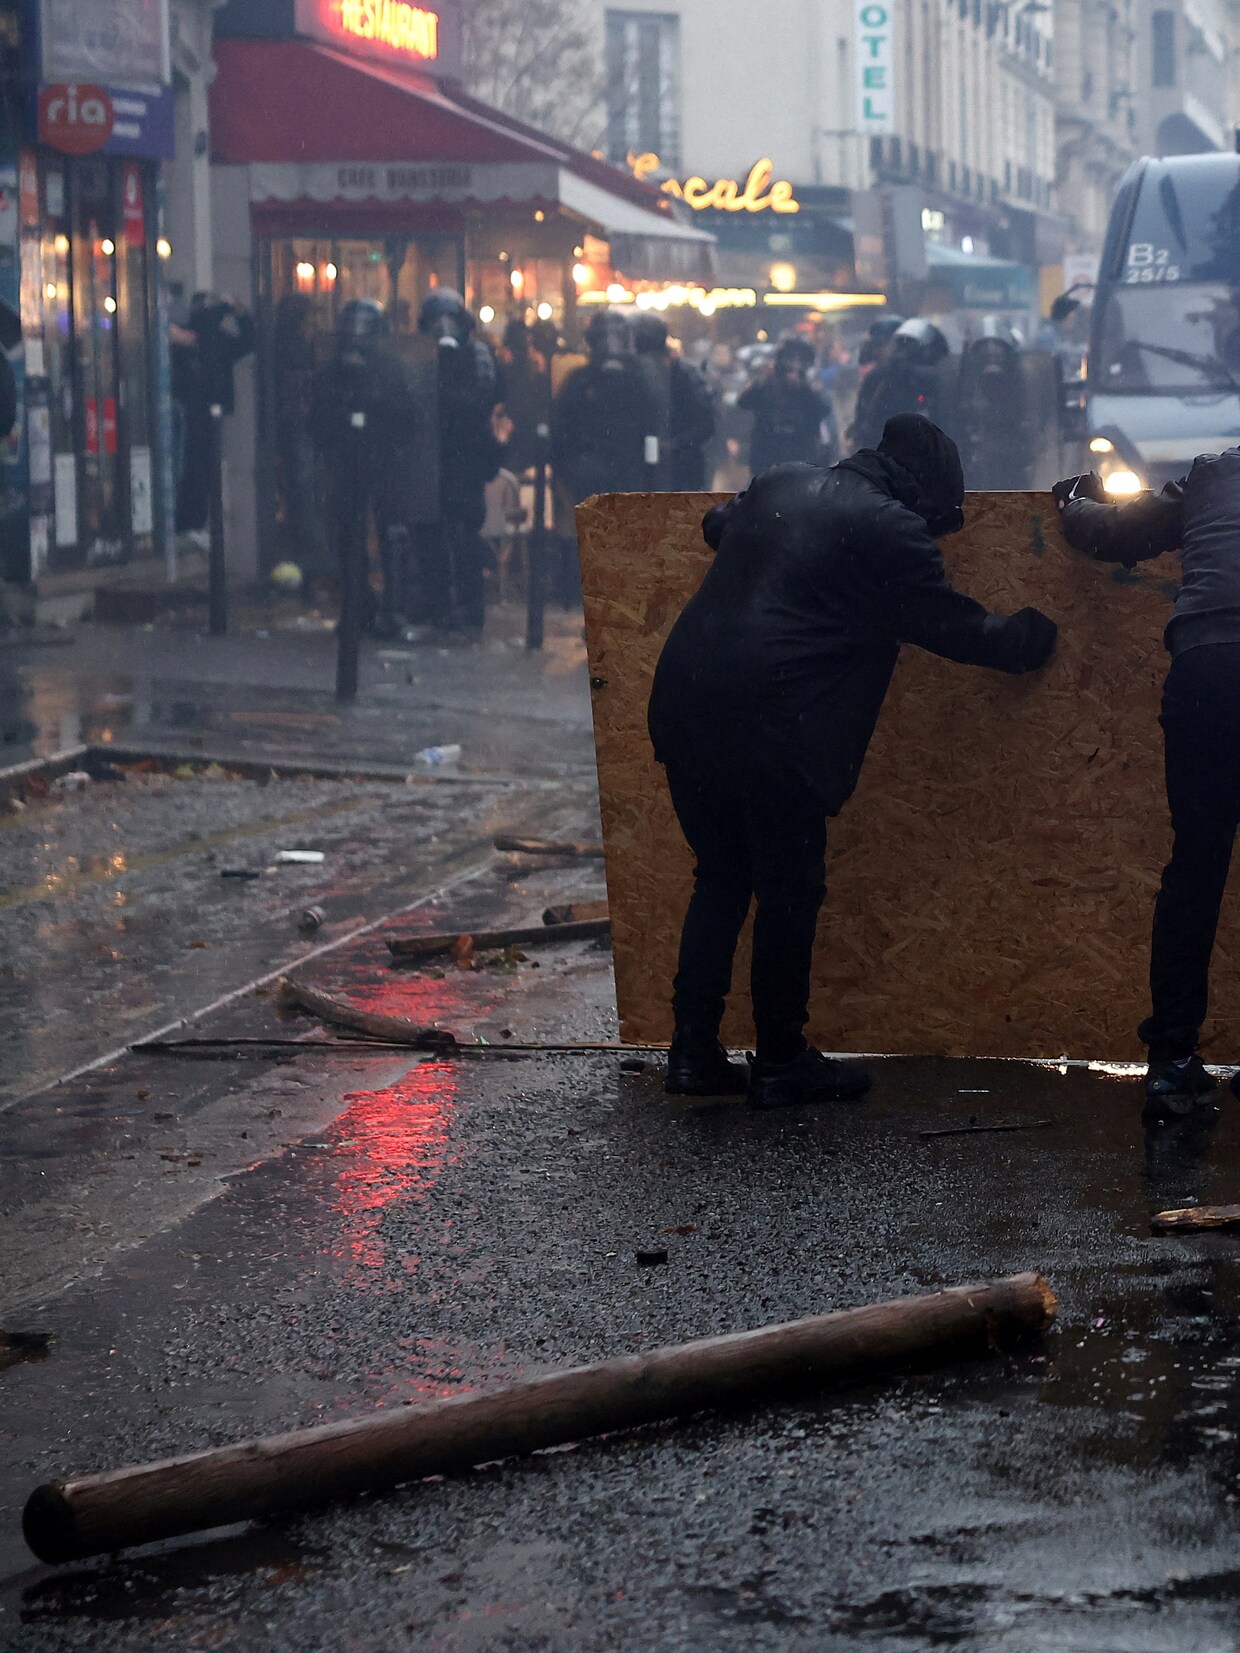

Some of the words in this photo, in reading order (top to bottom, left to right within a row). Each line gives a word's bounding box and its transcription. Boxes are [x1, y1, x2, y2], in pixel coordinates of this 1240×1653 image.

[859, 4, 888, 121] OTEL
[47, 85, 106, 125] ria
[1127, 243, 1169, 266] B2
